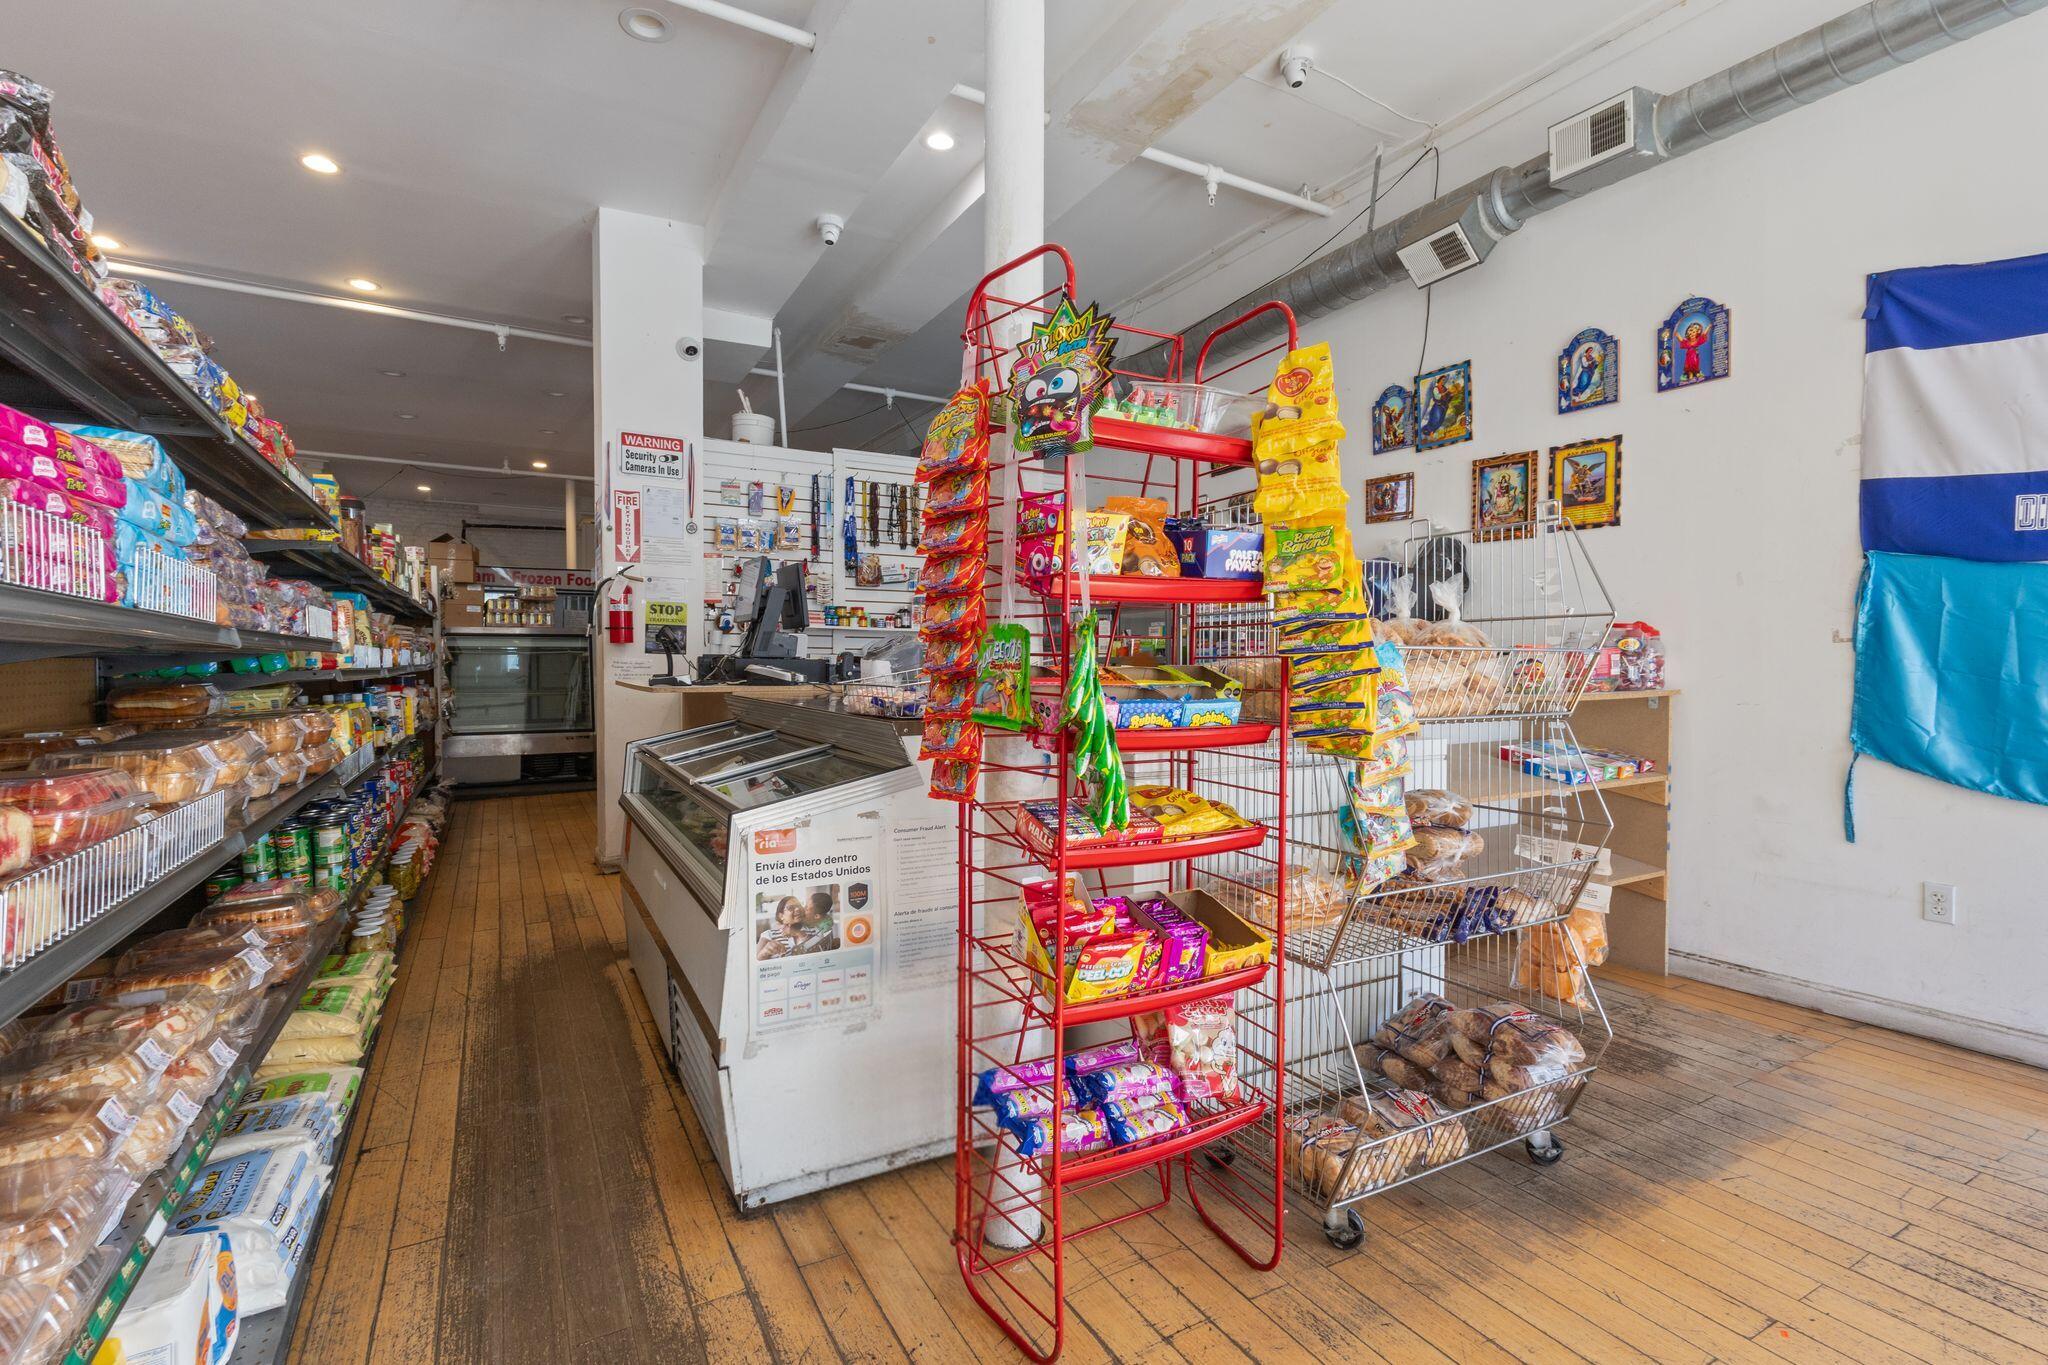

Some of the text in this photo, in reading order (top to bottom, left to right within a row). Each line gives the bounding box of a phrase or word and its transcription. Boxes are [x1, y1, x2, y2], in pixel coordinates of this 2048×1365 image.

[624, 435, 680, 451] WARNING
[625, 449, 656, 463] Security
[625, 461, 679, 476] Cameras In Use
[617, 496, 638, 506] FIRE
[1294, 528, 1331, 543] Banana
[1183, 539, 1193, 551] 10
[1281, 536, 1331, 553] Banana
[1181, 553, 1196, 562] PACK
[512, 571, 562, 585] Frozen
[649, 604, 684, 616] STOP
[1129, 713, 1173, 729] Bubbaloo
[1190, 710, 1231, 727] Bubbaloo
[1028, 822, 1055, 849] HALLS
[788, 858, 822, 869] dinero
[824, 854, 858, 865] dentro
[755, 866, 871, 886] de los Estados Unidos
[231, 1161, 251, 1186] Arroz
[272, 1203, 287, 1226] GOYA
